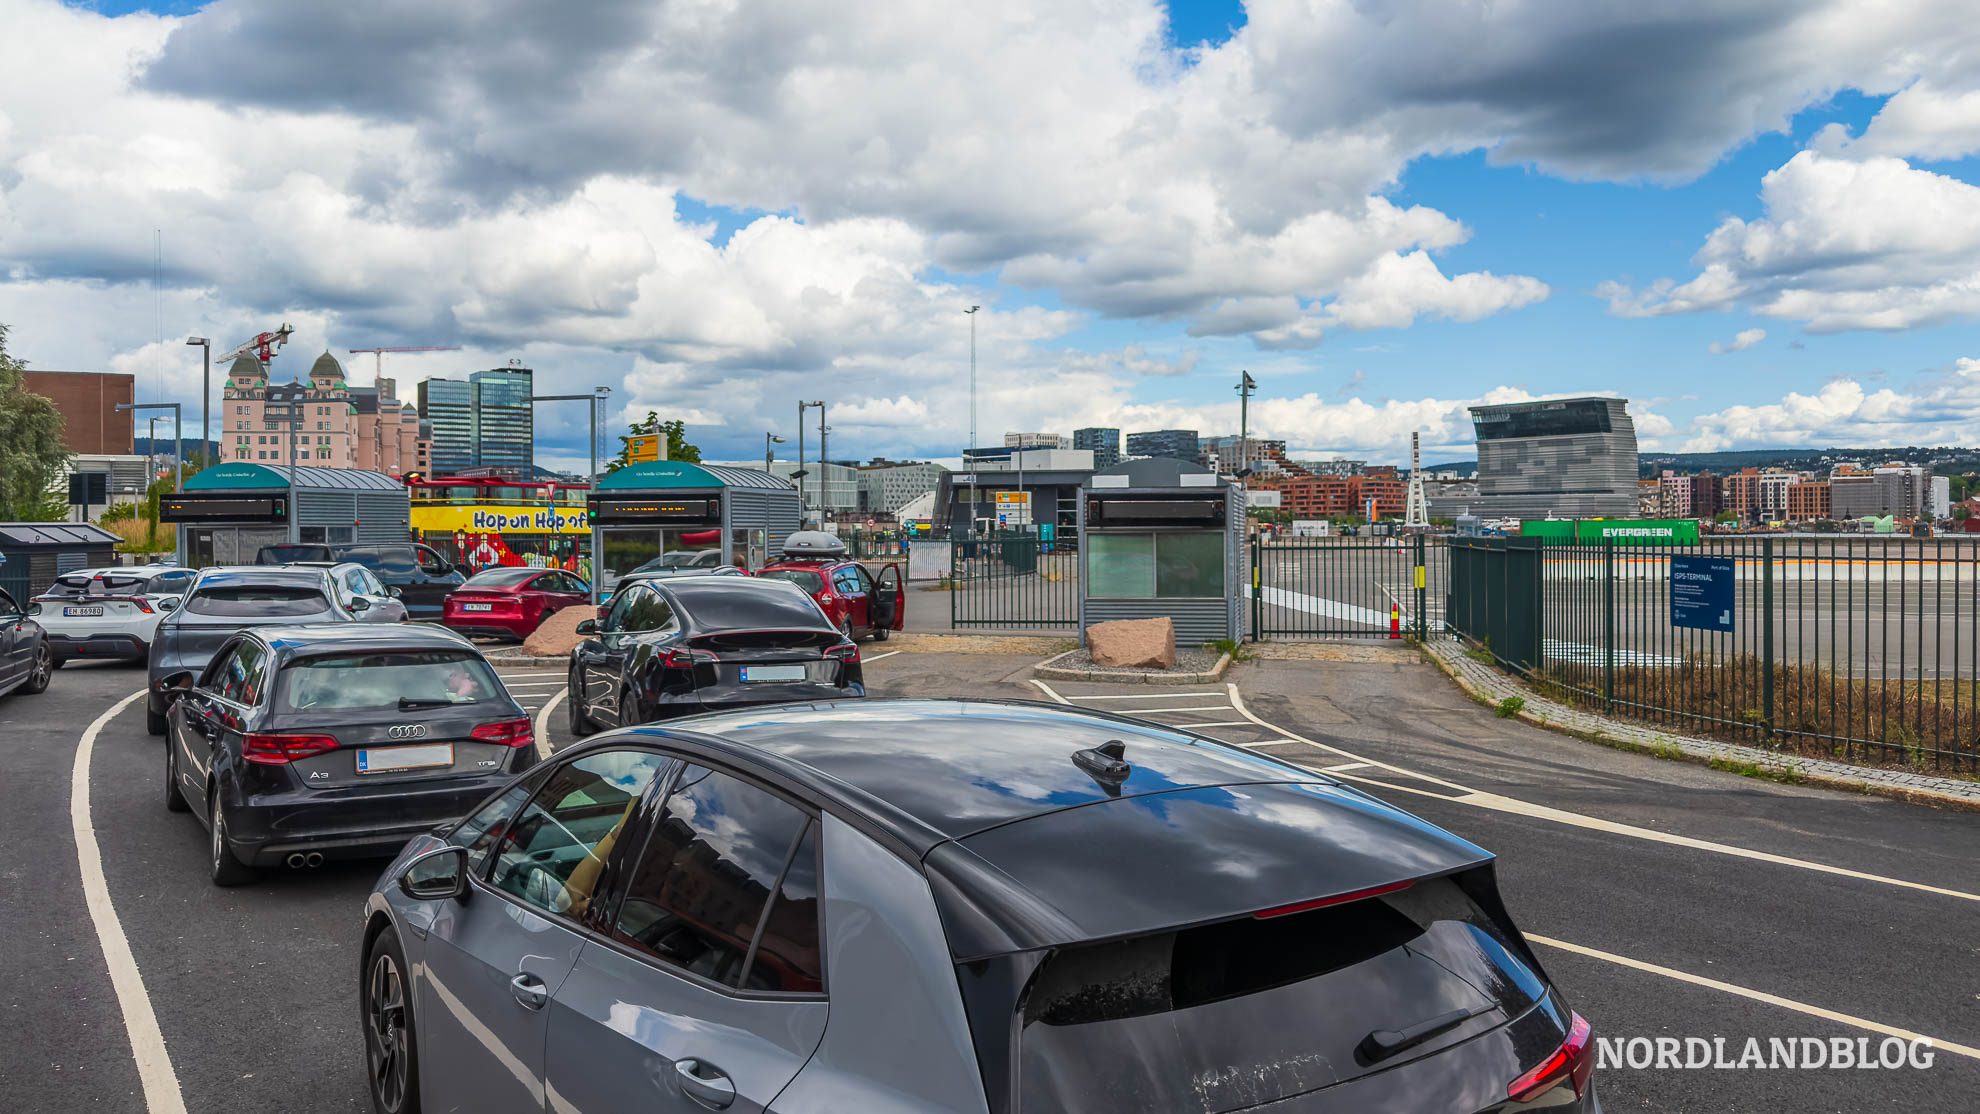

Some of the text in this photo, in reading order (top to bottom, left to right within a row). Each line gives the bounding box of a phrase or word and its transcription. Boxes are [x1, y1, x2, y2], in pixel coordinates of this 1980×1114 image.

[474, 510, 592, 532] Hop on Hop of
[1602, 528, 1672, 537] EVERGREEN
[310, 771, 329, 779] A3
